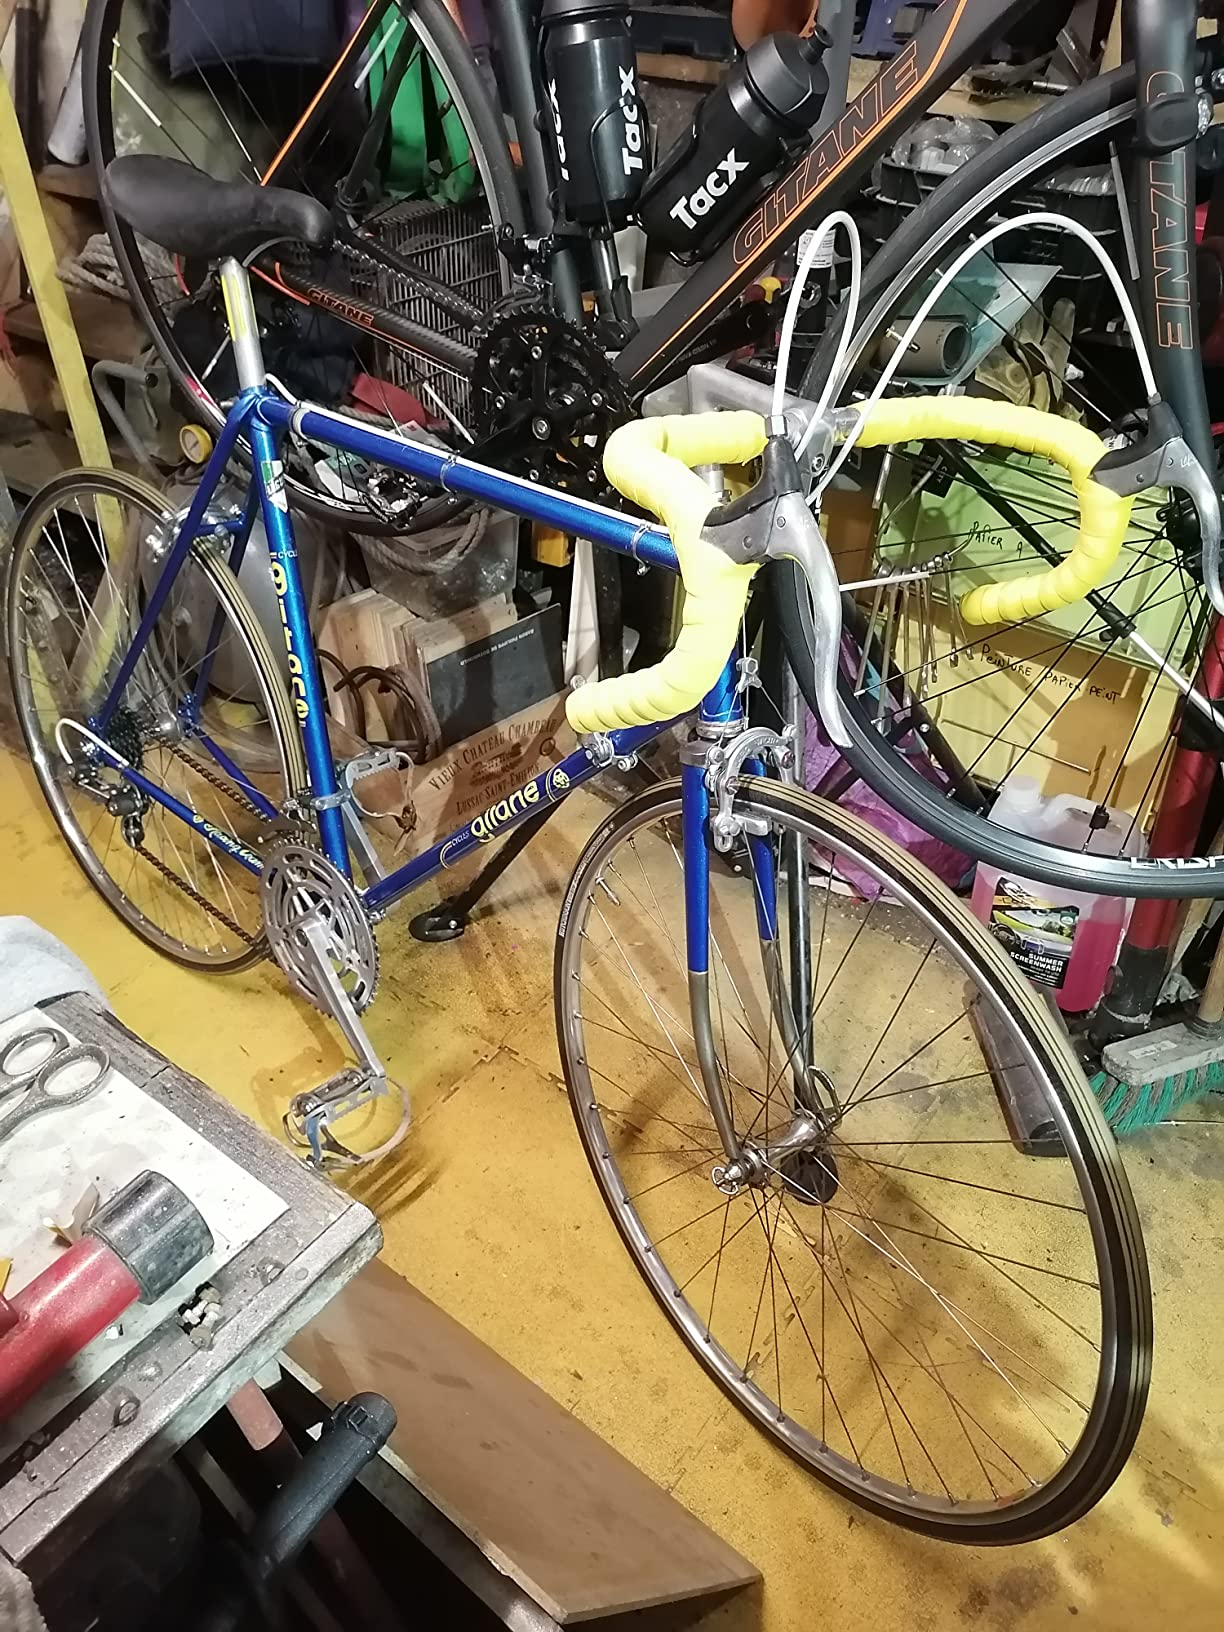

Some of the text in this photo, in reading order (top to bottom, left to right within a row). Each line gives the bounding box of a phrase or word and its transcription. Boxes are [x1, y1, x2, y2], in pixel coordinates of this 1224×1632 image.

[619, 66, 643, 175] Tacx
[733, 40, 918, 265] GITANE
[669, 147, 750, 230] Tacx
[1146, 71, 1194, 350] TANE
[307, 288, 374, 326] GITANE
[270, 561, 310, 719] gitane
[428, 758, 463, 791] VIEUX
[462, 730, 505, 765] CHATEAU
[1010, 951, 1062, 973] SCREENWASH
[1028, 952, 1063, 968] SUMMER
